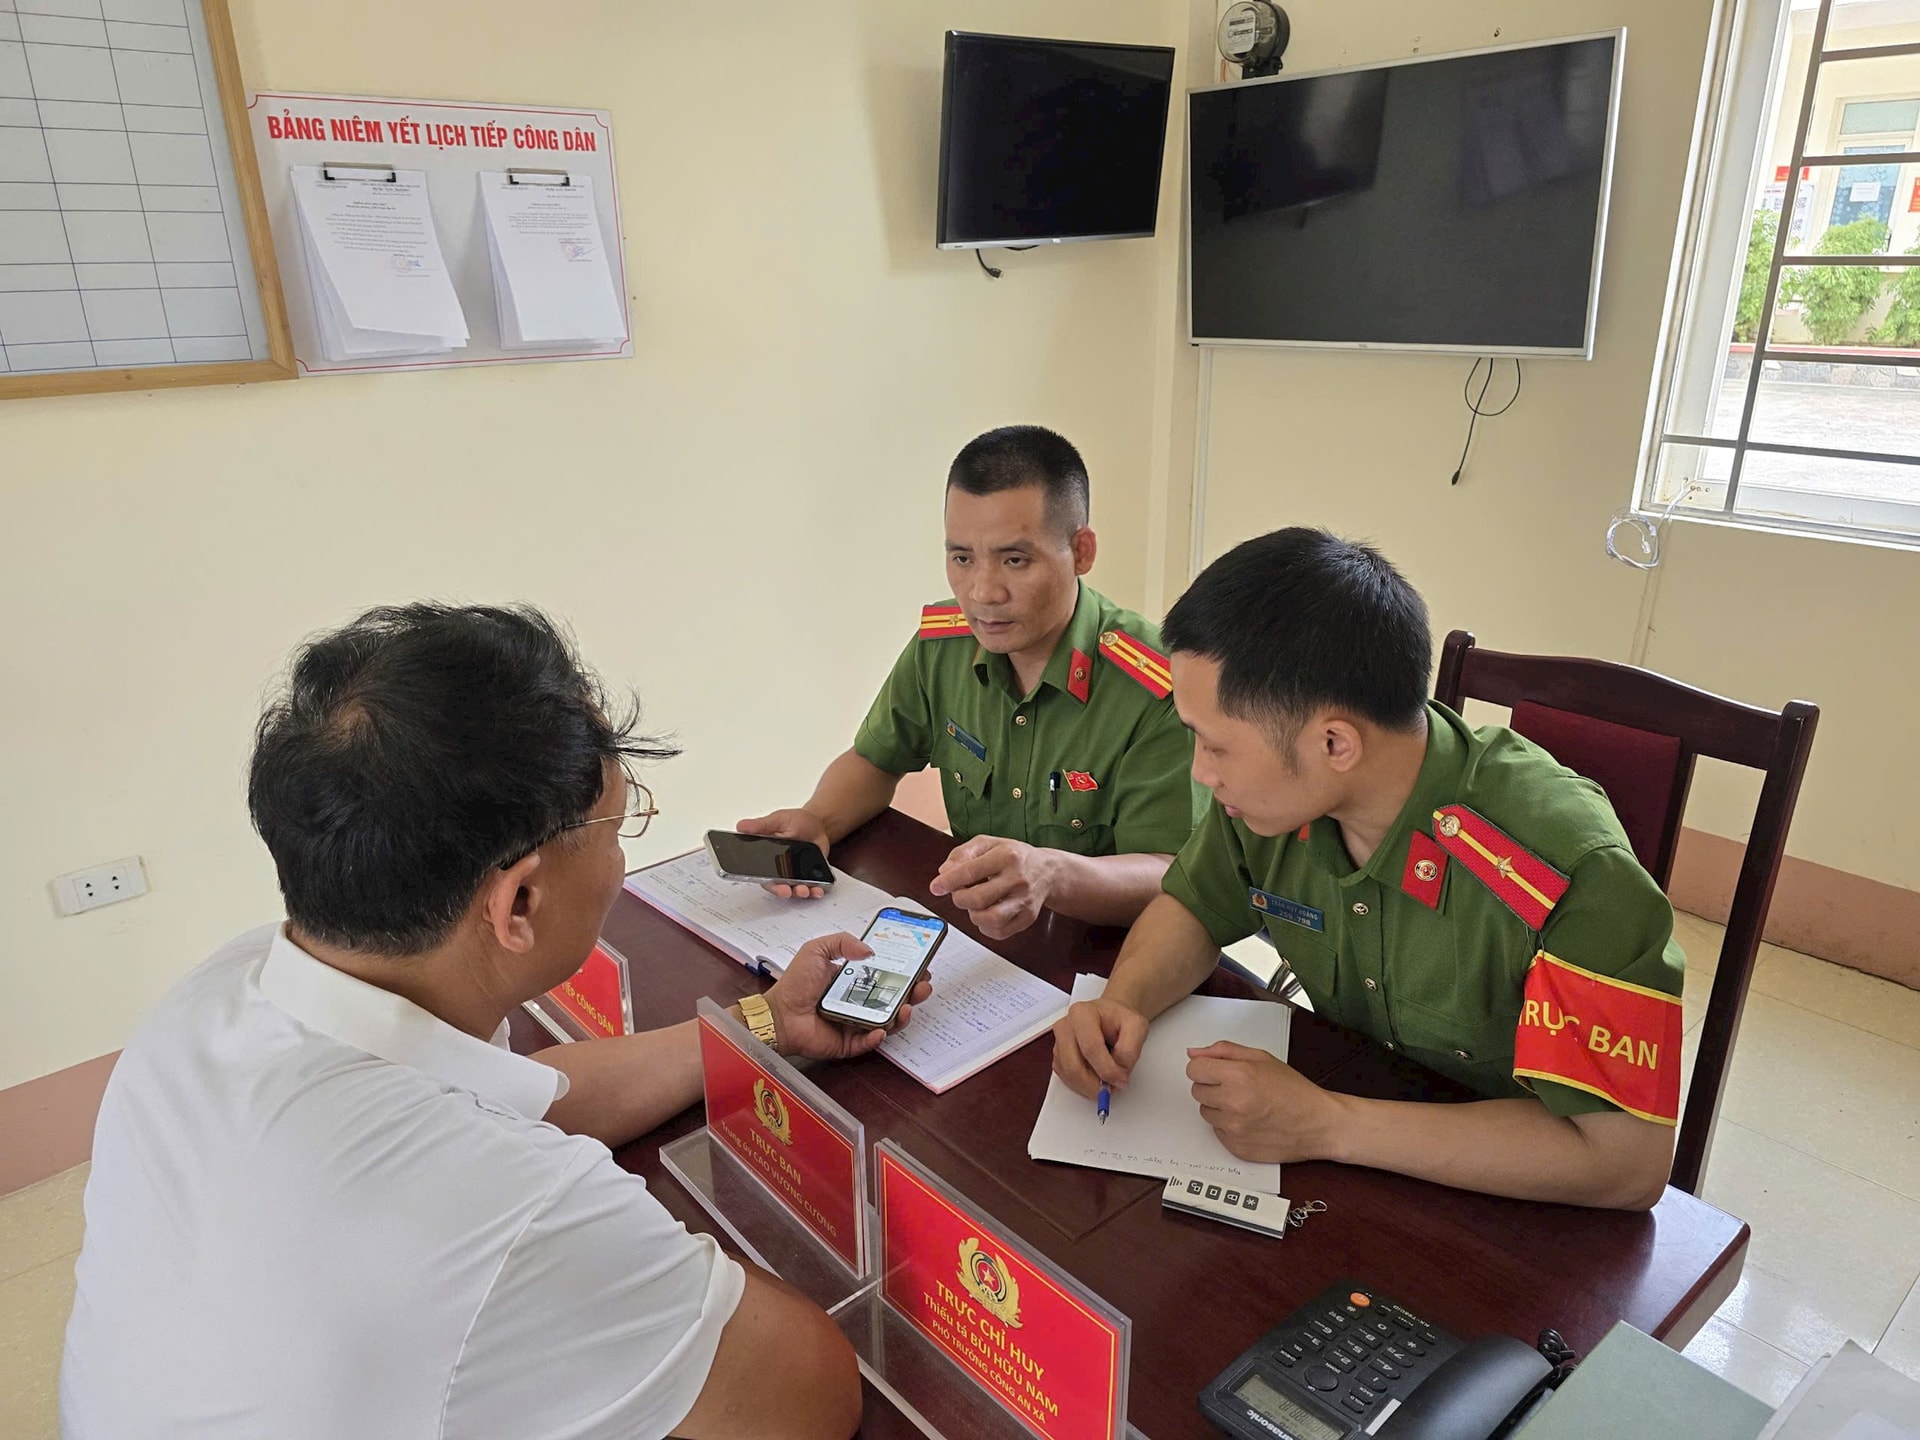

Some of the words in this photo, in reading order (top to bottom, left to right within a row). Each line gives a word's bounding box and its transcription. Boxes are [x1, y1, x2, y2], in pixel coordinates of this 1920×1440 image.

[267, 108, 326, 141] BẢNG
[330, 115, 384, 143] NIÊM
[387, 115, 420, 145] YẾT
[426, 123, 467, 150] LỊCH
[470, 120, 508, 148] TIẾP
[513, 124, 559, 150] CÔNG
[563, 127, 597, 152] DÂN
[576, 993, 597, 1020] CÔNG
[596, 1012, 615, 1036] DÂN
[1588, 1024, 1658, 1070] BAN
[721, 1121, 742, 1148] Trung
[753, 1150, 770, 1173] CAO
[771, 1167, 803, 1205] VƯƠNG
[749, 1127, 777, 1162] TRỰC
[779, 1155, 802, 1186] BAN
[923, 1292, 954, 1326] Thiếu
[956, 1321, 968, 1338] tá
[970, 1332, 991, 1359] BÙI
[994, 1353, 1023, 1386] HỮU
[1026, 1381, 1059, 1417] NAM
[936, 1279, 977, 1326] TRỰC
[979, 1318, 1006, 1350] CHỈ
[1010, 1342, 1045, 1381] HUY
[932, 1319, 951, 1340] PHÓ
[990, 1370, 1016, 1398] CÔNG
[1017, 1394, 1031, 1412] AN
[1246, 1409, 1294, 1440] anasonic
